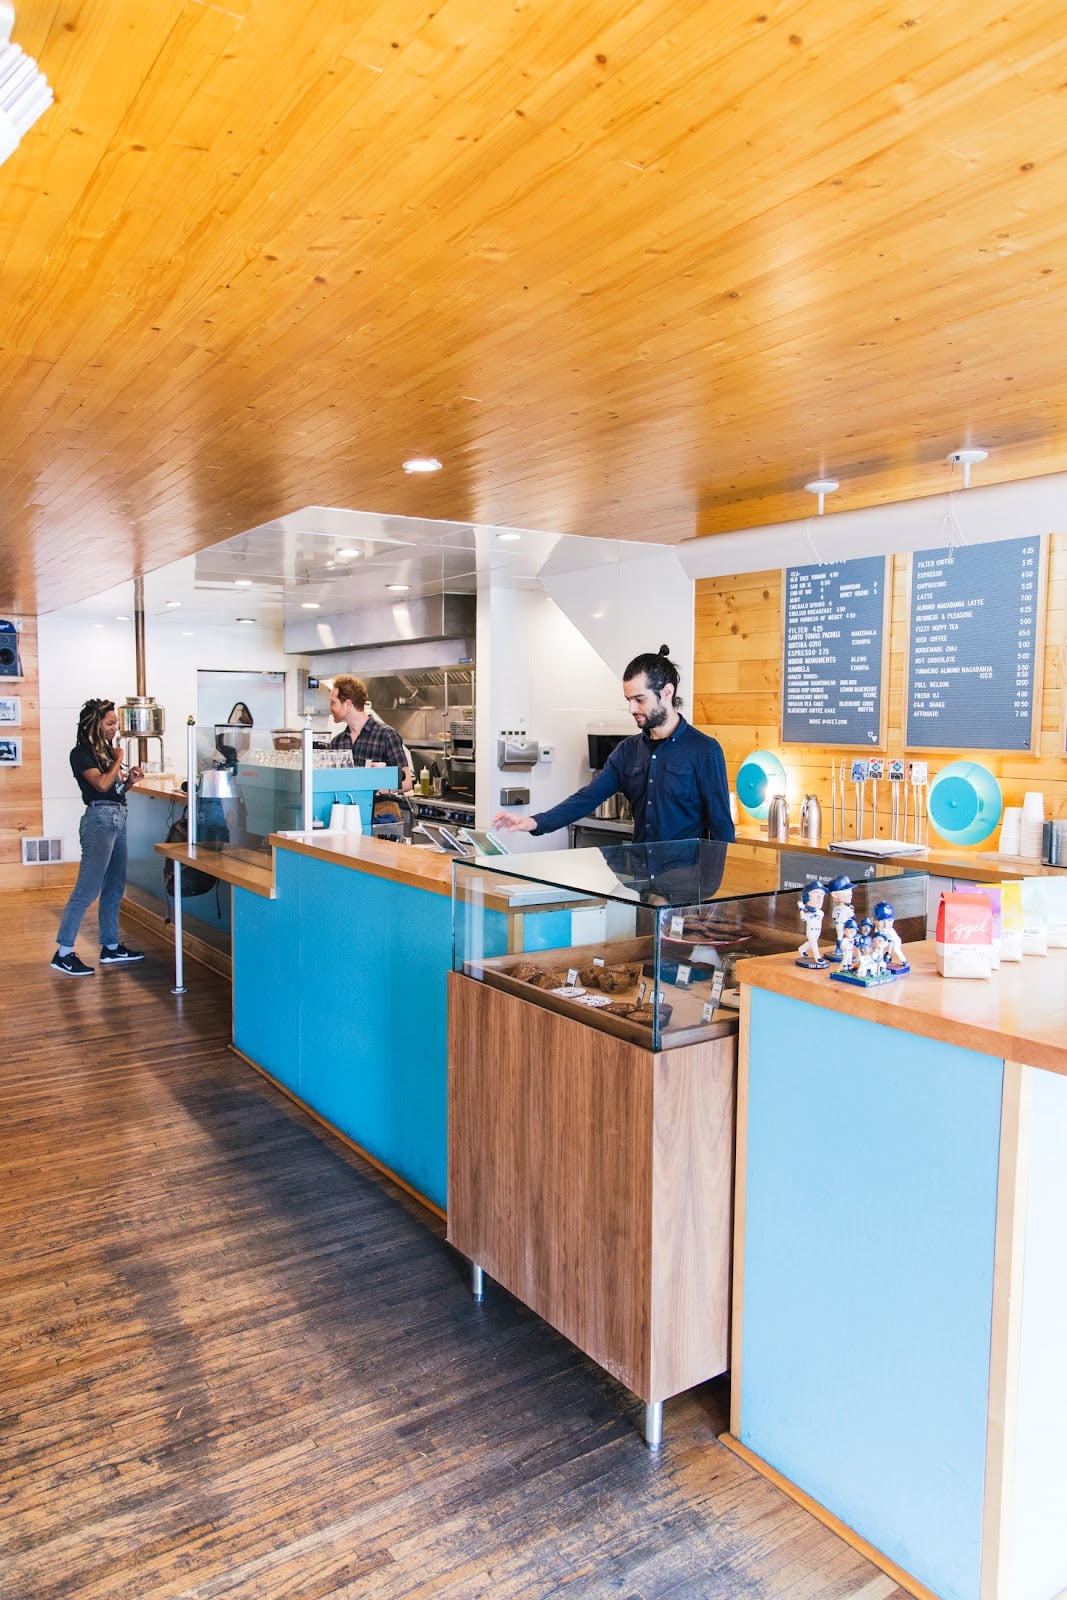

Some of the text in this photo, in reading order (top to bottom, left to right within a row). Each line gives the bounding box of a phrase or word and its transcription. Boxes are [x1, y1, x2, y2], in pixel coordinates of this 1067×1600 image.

[918, 560, 934, 568] FILTER
[936, 558, 955, 566] COFFEE
[917, 571, 943, 579] ESPRESSO
[917, 581, 947, 590] CAPPUCCINO
[917, 593, 934, 601] LATTE
[937, 601, 965, 609] MACADAMIA
[967, 599, 985, 607] LATTE
[929, 635, 948, 643] COFFEE
[927, 656, 955, 664] CHOCOLATE
